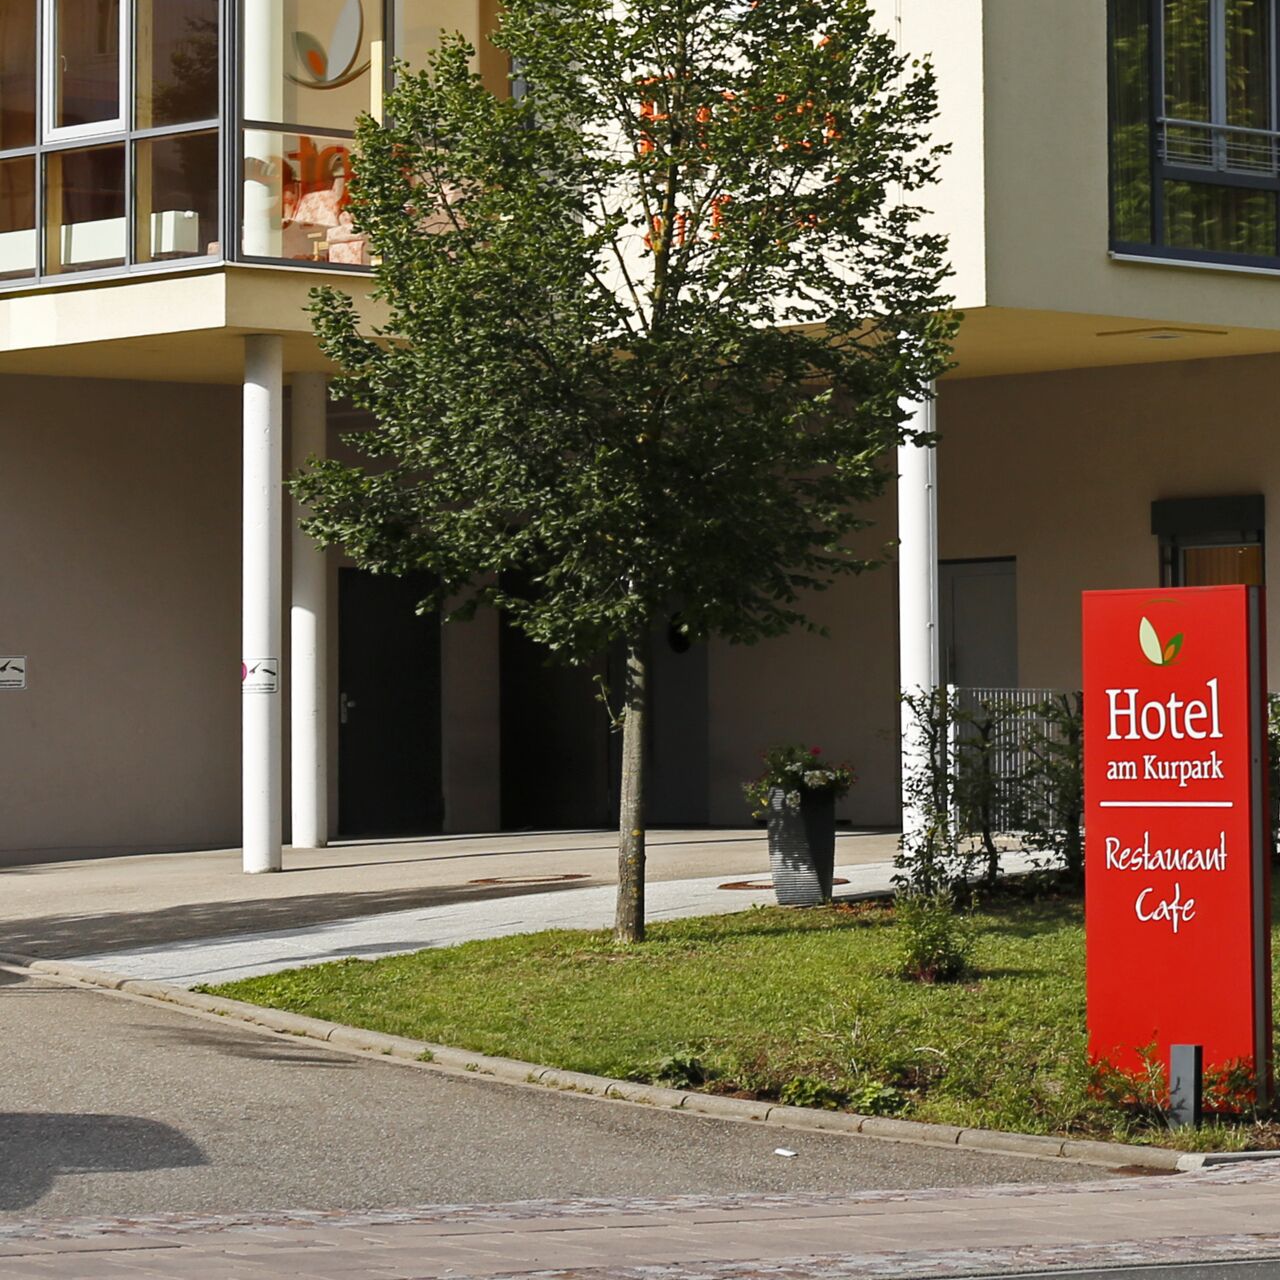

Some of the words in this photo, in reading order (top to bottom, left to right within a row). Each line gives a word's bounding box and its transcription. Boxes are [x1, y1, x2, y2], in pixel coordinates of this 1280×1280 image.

[1106, 678, 1223, 739] Hotel
[1107, 762, 1137, 779] am
[1143, 751, 1224, 786] Kurpark
[1106, 831, 1227, 870] Restaurant
[1136, 883, 1195, 933] Cafe
